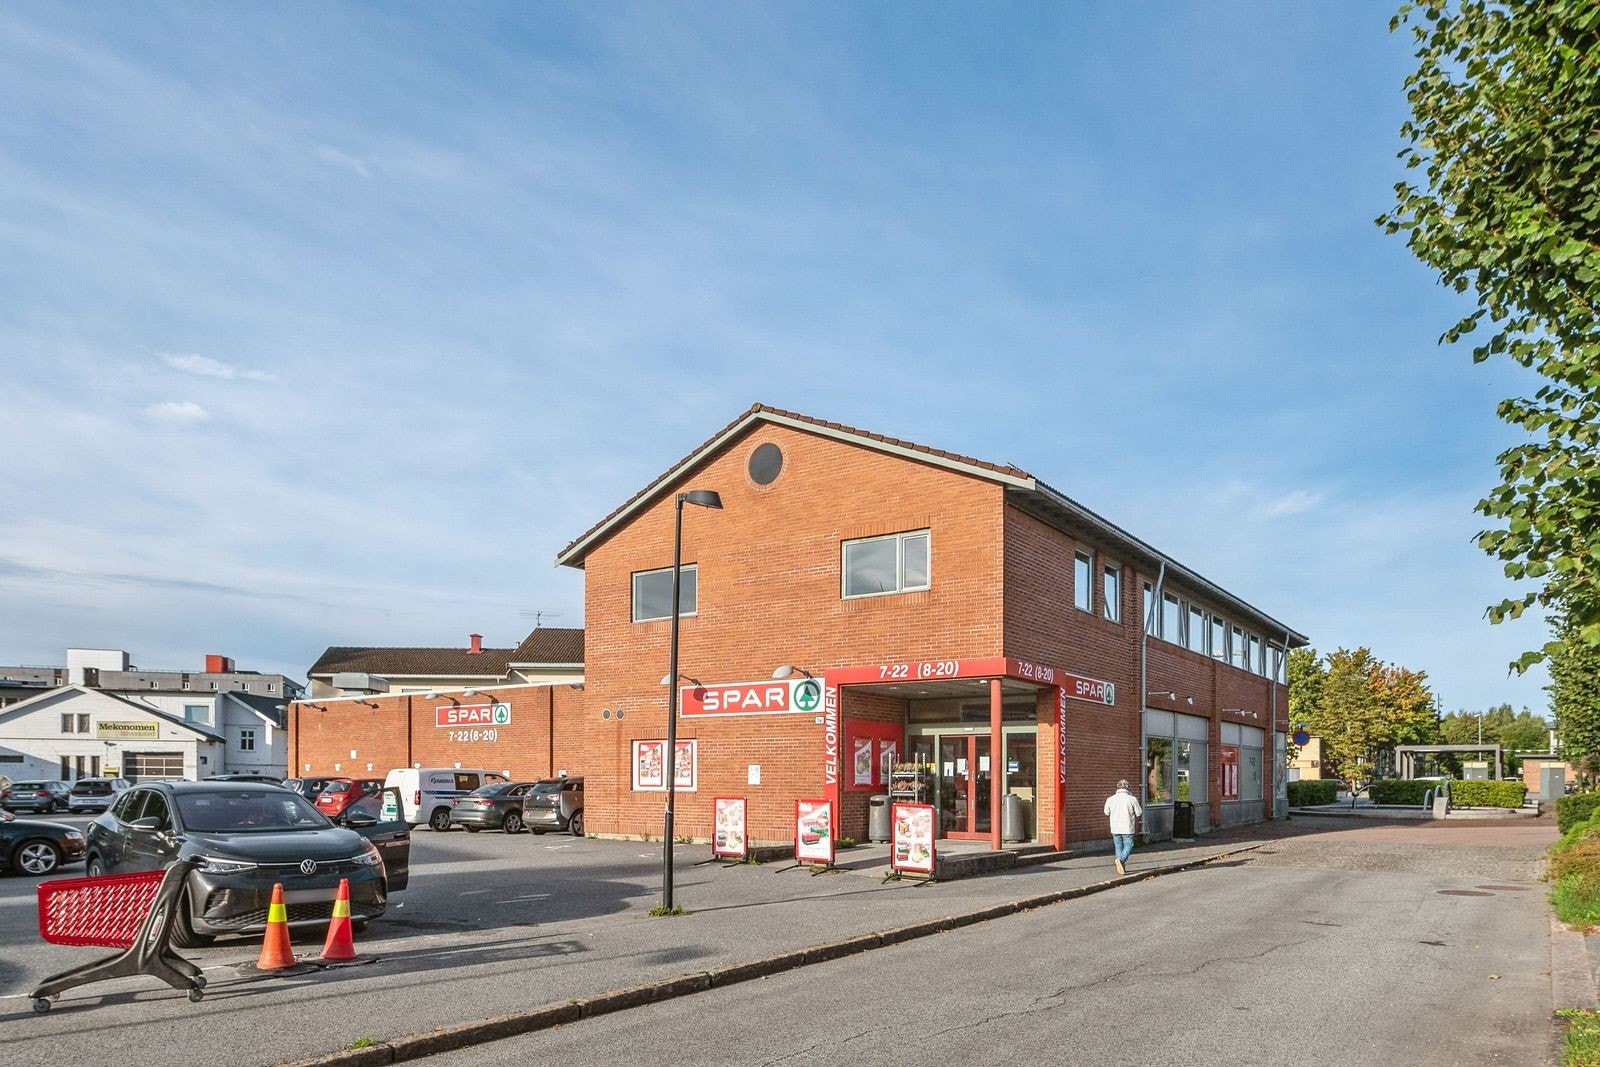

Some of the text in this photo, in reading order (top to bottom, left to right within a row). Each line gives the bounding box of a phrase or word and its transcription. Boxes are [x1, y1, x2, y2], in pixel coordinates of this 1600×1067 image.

[879, 660, 959, 679] 7-22 (8-20)
[1018, 661, 1054, 684] 7-22 (8-20)
[702, 687, 785, 711] SPAR
[1075, 680, 1104, 699] SPAR
[447, 708, 491, 723] SPAR
[99, 722, 156, 732] Mekonomen
[825, 686, 838, 785] VELKOMMEN
[1059, 687, 1067, 784] VELKOMMEN
